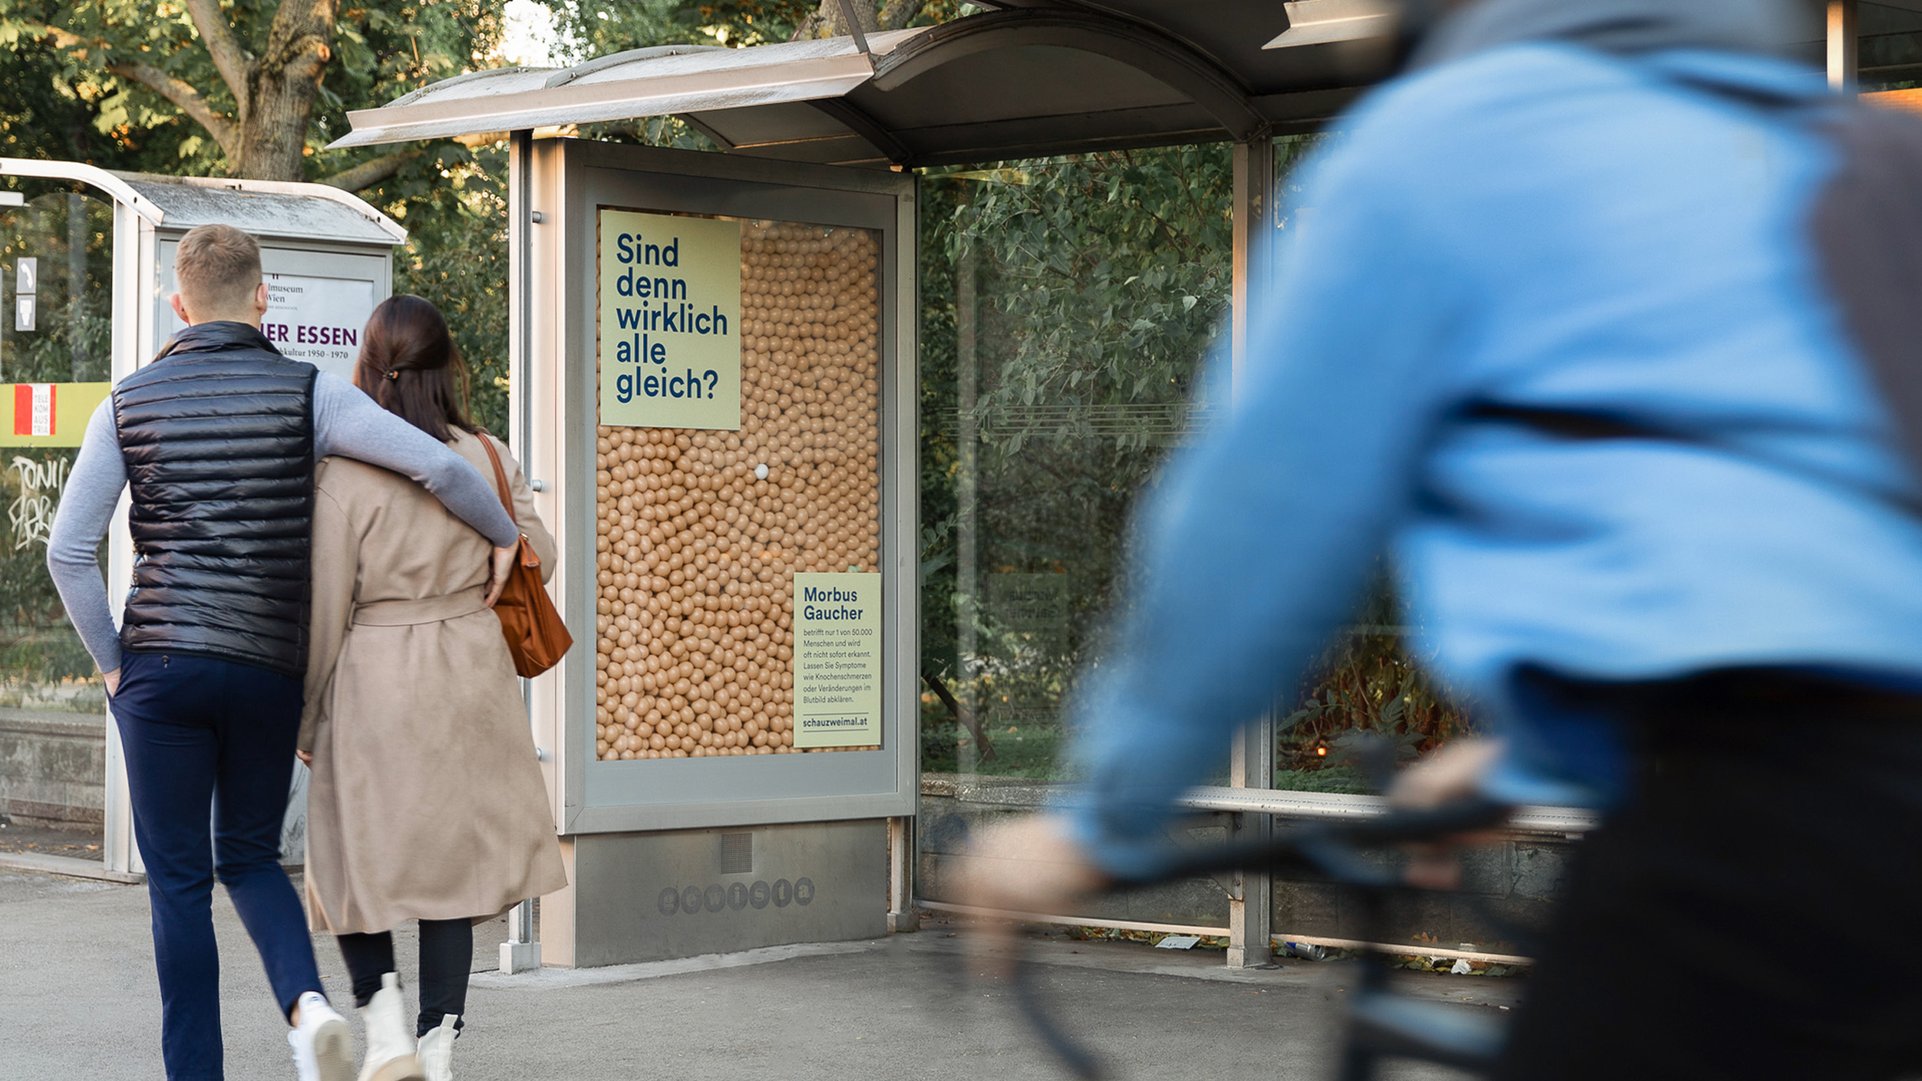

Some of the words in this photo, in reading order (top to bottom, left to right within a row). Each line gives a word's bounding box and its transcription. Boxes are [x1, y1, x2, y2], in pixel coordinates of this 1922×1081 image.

[616, 233, 679, 267] Sind
[268, 283, 304, 294] lmuseum
[616, 267, 687, 300] denn
[616, 300, 728, 336] wirklich
[297, 325, 357, 346] ESSEN
[308, 349, 326, 358] 1950
[331, 351, 349, 360] 1970
[616, 333, 666, 365] alle
[616, 366, 719, 404] gleich?
[804, 586, 858, 602] Morbus
[804, 604, 863, 620] Gaucher
[803, 628, 824, 636] betrifft
[835, 639, 846, 647] und
[847, 639, 861, 647] wird
[803, 650, 812, 658] oft
[813, 650, 828, 658] nicht
[829, 650, 847, 658] sofort
[848, 650, 872, 658] erkannt.
[803, 661, 823, 670] Lassen
[824, 661, 834, 670] Sie
[835, 661, 867, 670] Symptome
[803, 673, 814, 681] wie
[815, 672, 873, 681] Knochenschmerzen
[803, 684, 817, 693] oder
[818, 683, 863, 693] Veränderungen
[864, 682, 872, 691] im
[803, 695, 826, 704] Blutbild
[803, 716, 868, 728] schauzweimal.at
